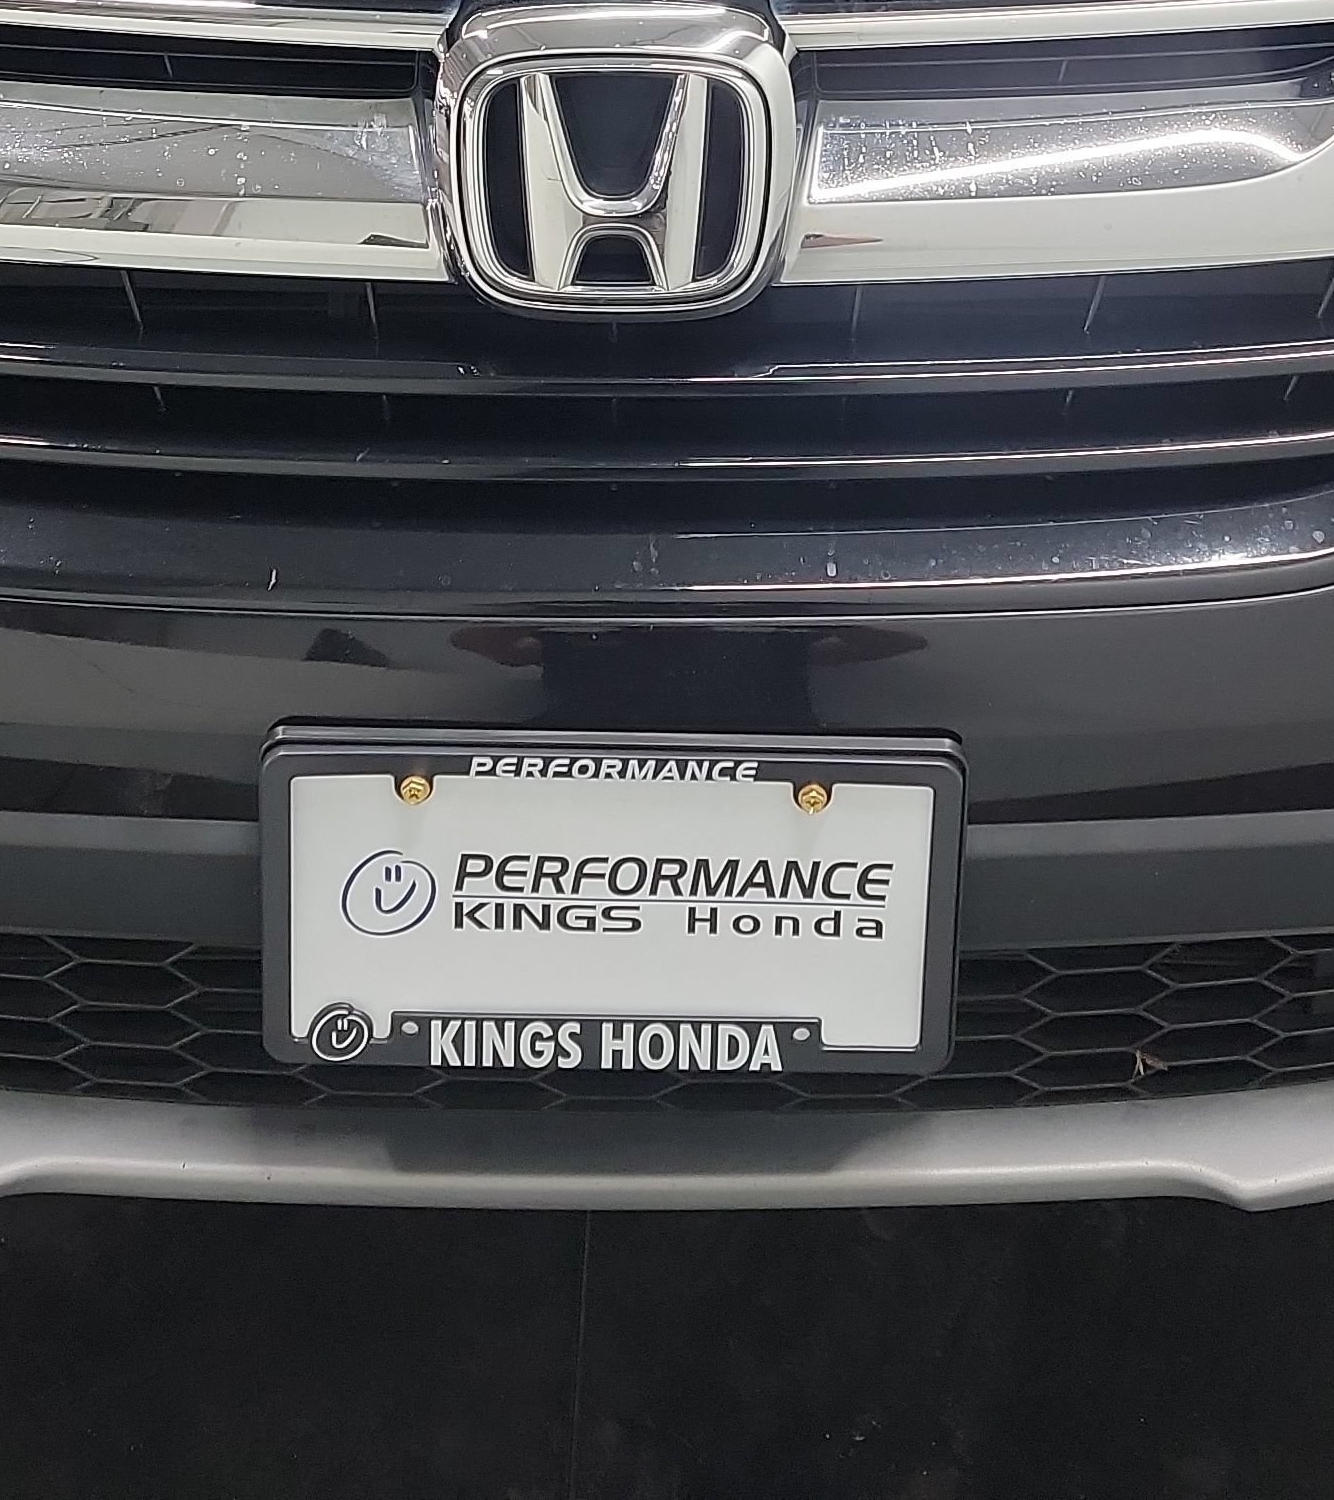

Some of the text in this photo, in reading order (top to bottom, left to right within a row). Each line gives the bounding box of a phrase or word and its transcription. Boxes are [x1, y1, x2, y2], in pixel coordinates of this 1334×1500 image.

[469, 757, 759, 782] PERFORMANCE
[453, 853, 894, 902] PERFORMANCE
[452, 902, 886, 940] KINGS Honda
[430, 1019, 783, 1071] KINGS HONDA
